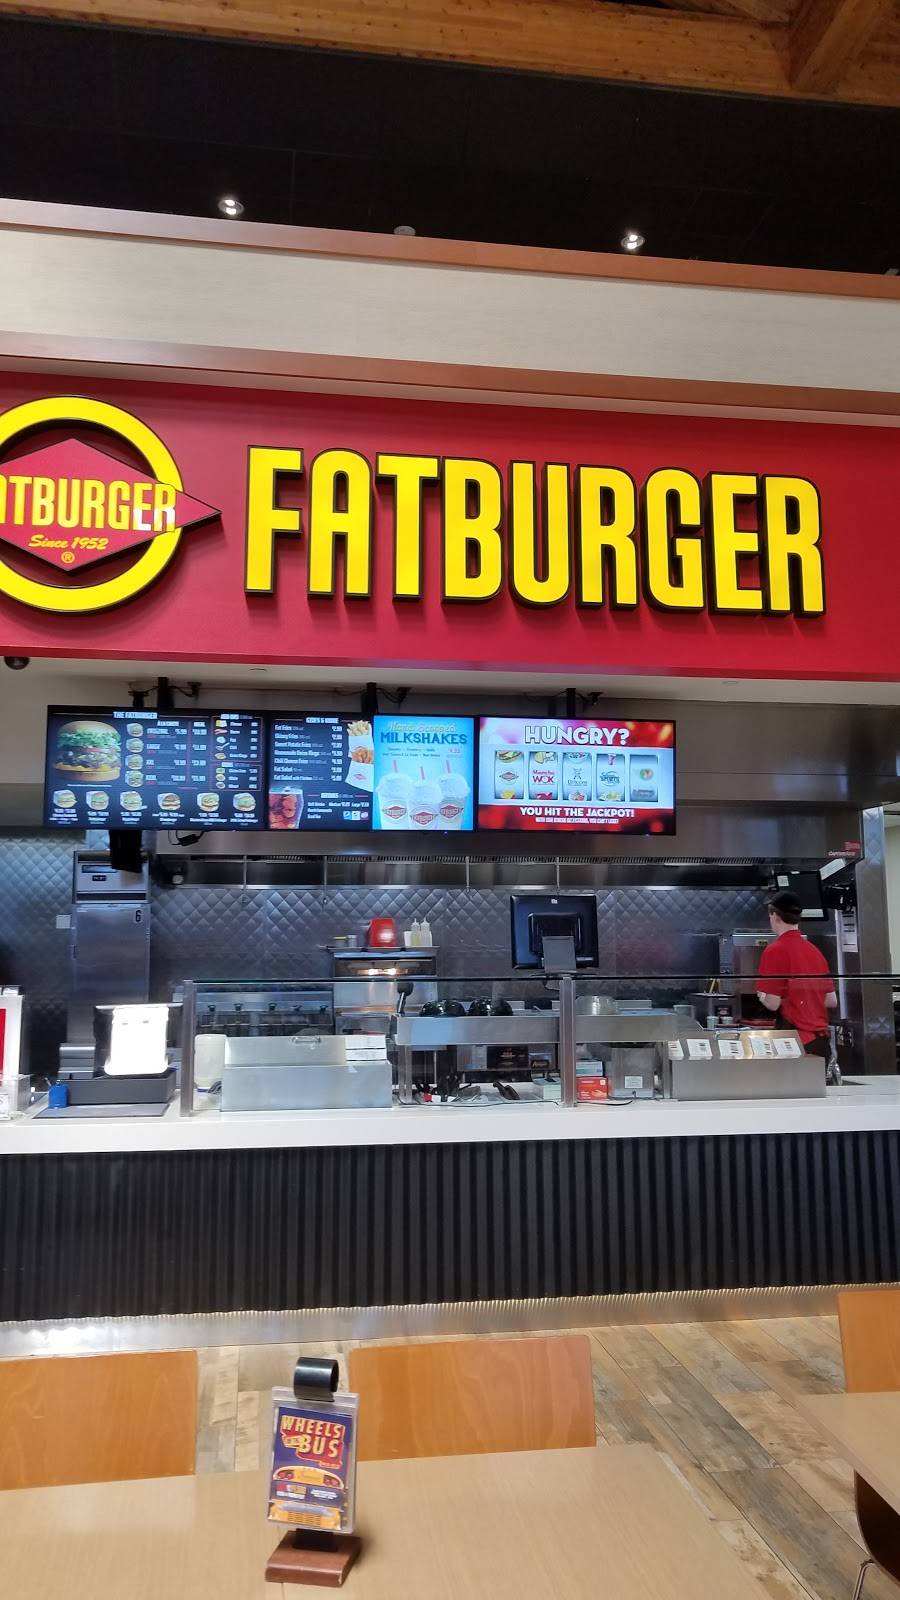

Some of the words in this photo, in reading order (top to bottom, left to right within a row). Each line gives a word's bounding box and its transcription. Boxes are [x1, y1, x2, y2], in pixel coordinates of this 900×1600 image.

[245, 444, 824, 615] FATBURGER
[28, 534, 69, 548] Since
[71, 536, 109, 550] 1952
[380, 732, 468, 745] MILKSHAKES
[525, 725, 630, 745] HUNGRY?
[532, 775, 555, 784] WOK
[520, 807, 542, 816] YOU
[544, 807, 563, 816] HIT
[564, 808, 584, 817] THE
[586, 808, 635, 818] JACKPOT!
[135, 909, 142, 923] 6
[281, 1416, 341, 1439] WHEELS
[298, 1434, 339, 1458] BUS
